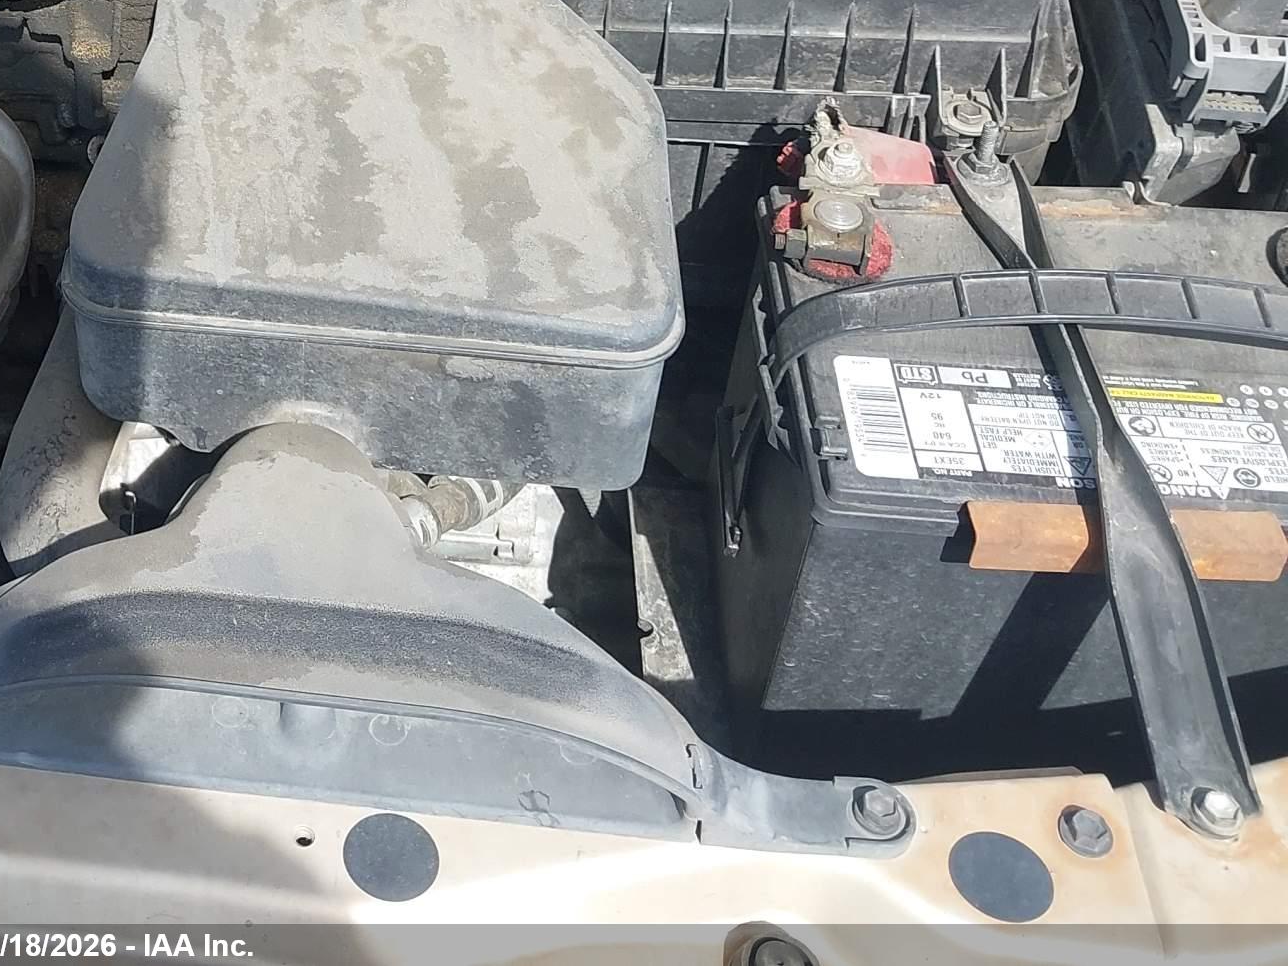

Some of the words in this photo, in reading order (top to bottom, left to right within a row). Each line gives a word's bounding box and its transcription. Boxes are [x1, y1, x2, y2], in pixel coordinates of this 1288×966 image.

[961, 371, 989, 384] Pb
[931, 412, 943, 420] 95
[1001, 428, 1022, 436] HELP
[979, 433, 1015, 442] MEDICAL
[1003, 457, 1057, 467] IMMEDIATELY
[1240, 458, 1286, 467] EXPLOSIVE
[1035, 466, 1061, 475] FLUSH
